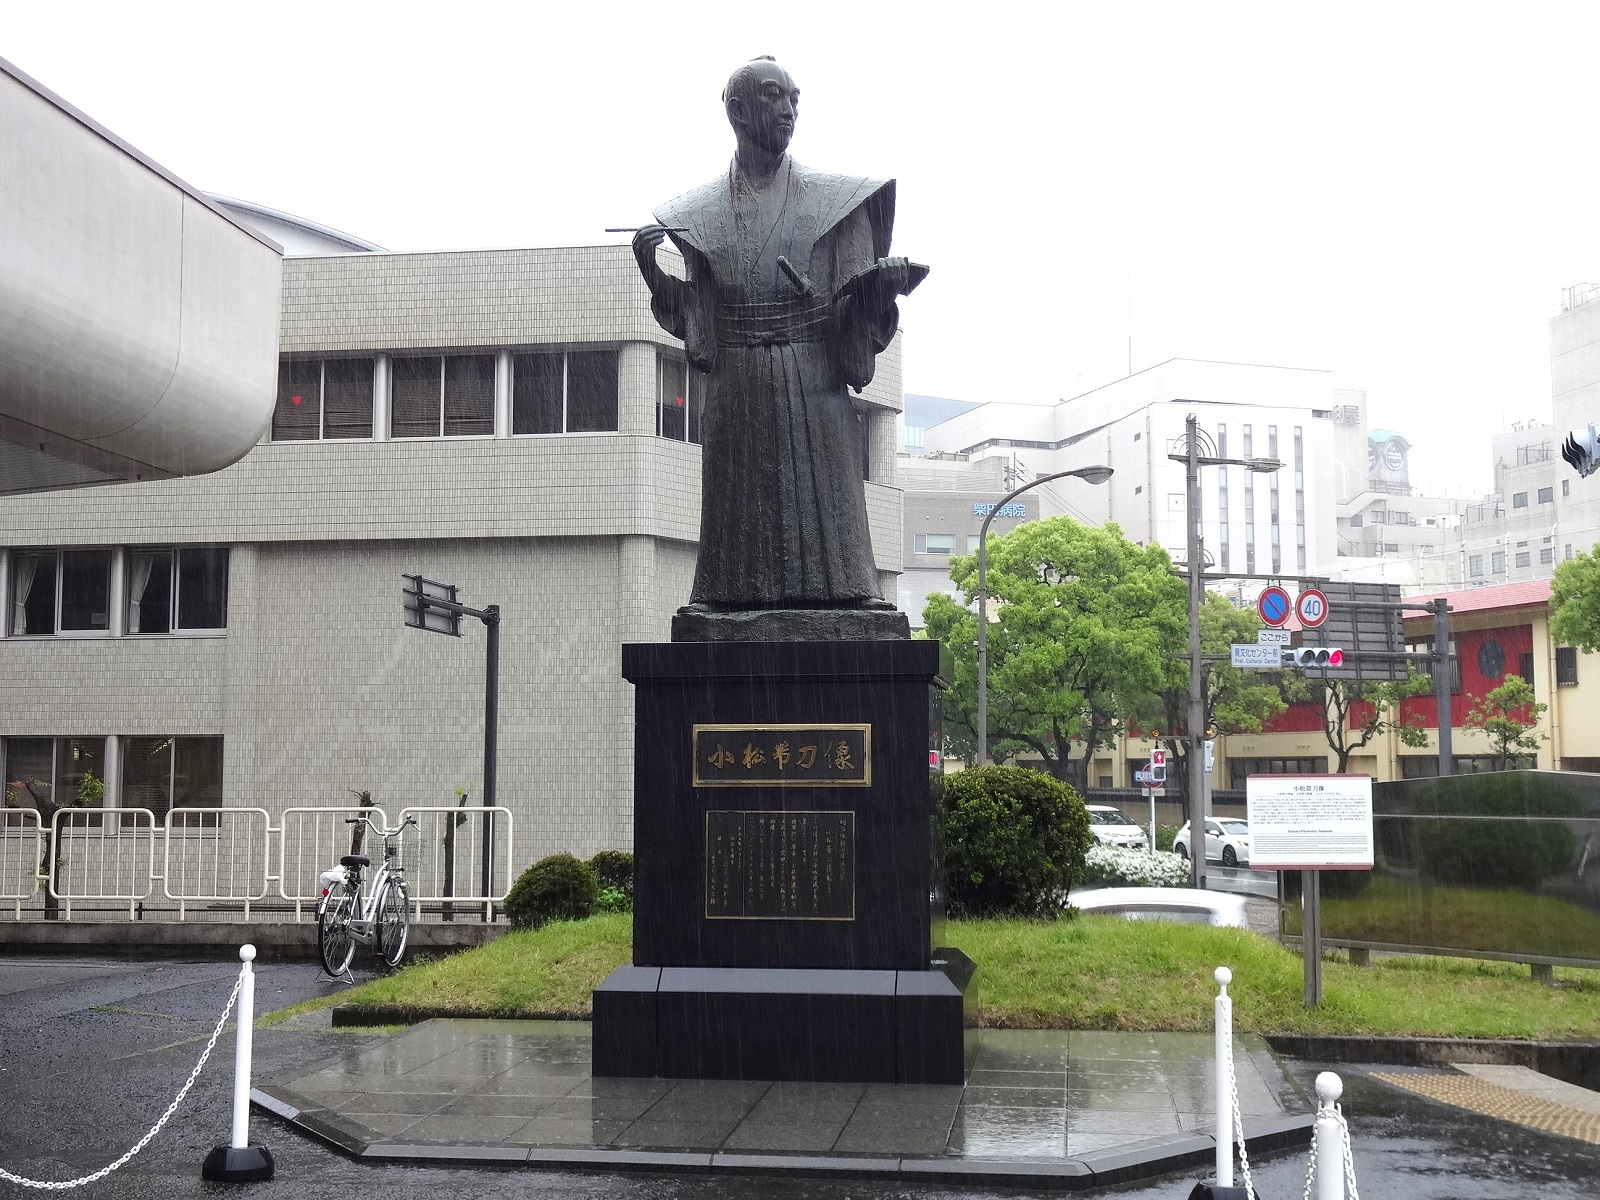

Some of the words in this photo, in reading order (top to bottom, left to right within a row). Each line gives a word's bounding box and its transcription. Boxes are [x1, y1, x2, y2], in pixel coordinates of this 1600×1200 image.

[1304, 599, 1321, 617] 40
[1260, 632, 1289, 642] ここから
